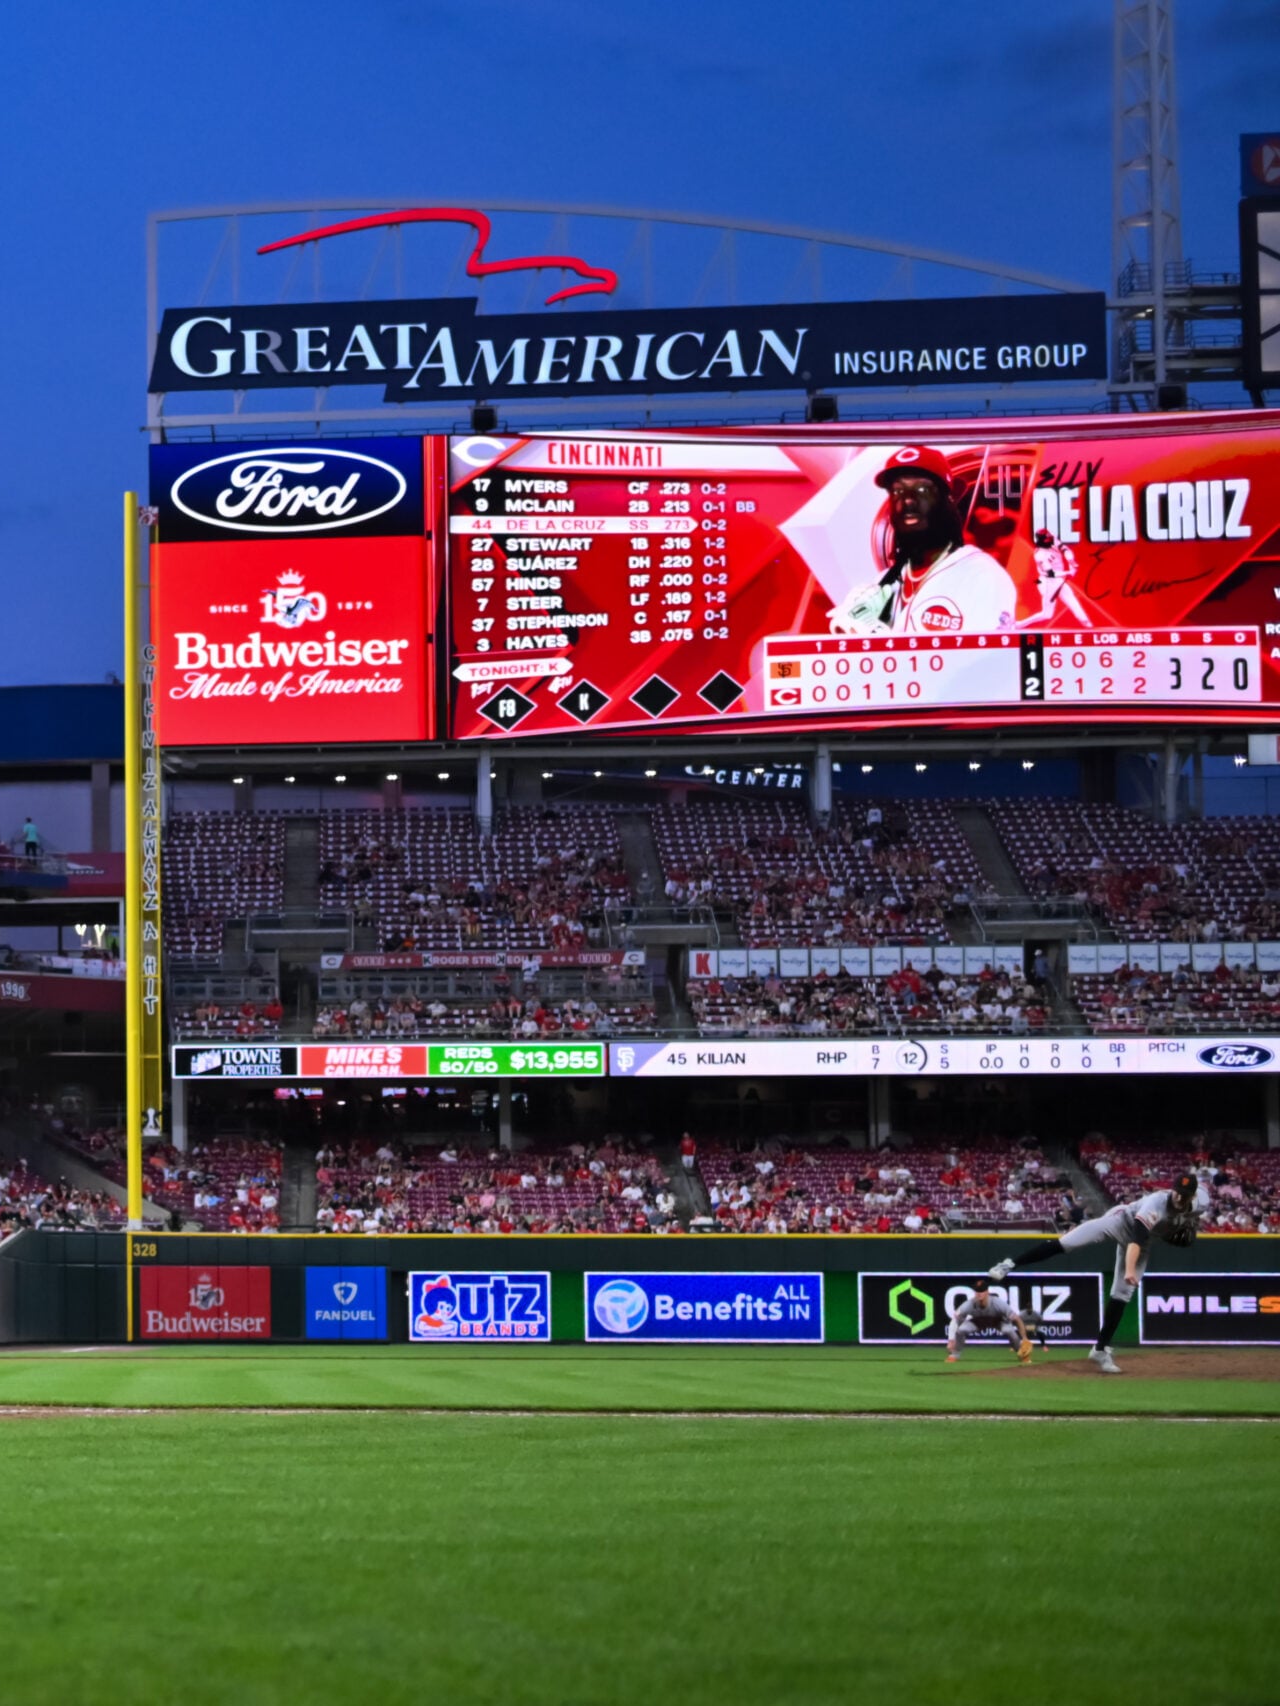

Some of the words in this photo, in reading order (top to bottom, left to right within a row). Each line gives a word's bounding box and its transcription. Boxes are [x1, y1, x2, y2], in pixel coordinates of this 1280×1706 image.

[170, 316, 429, 378] GREAT
[402, 327, 810, 391] AMERICAN
[833, 347, 988, 376] INSURANCE
[996, 342, 1088, 371] GROUP
[548, 443, 662, 467] CINCINNATI
[216, 460, 361, 518] Ford
[472, 479, 491, 493] 17
[505, 480, 568, 493] MYERS
[628, 482, 649, 494] CF
[659, 482, 691, 495] .273
[701, 483, 726, 495] 0-2
[476, 499, 488, 512] 9
[505, 500, 574, 512] MCLAIN
[628, 501, 650, 513] 2B
[660, 501, 691, 512] .213
[702, 501, 725, 513] 0-1
[736, 501, 756, 512] BB
[1032, 486, 1080, 543] DE
[1089, 485, 1138, 543] LA
[1144, 479, 1252, 541] CRUZ
[472, 519, 492, 530] 44
[506, 520, 529, 530] DE
[535, 520, 557, 530] LA
[562, 520, 606, 530] CRUZ
[629, 519, 649, 530] SS
[701, 519, 727, 530] 0-2
[471, 539, 493, 551] 27
[506, 538, 592, 551] STEWART
[631, 538, 648, 550] 1B
[660, 538, 691, 550] .316
[703, 537, 725, 549] 1-2
[471, 558, 494, 572] 28
[506, 555, 577, 570] SUÁREZ
[628, 556, 651, 568] DH
[659, 556, 692, 568] .220
[703, 555, 726, 567] 0-1
[472, 578, 494, 591] 57
[506, 577, 562, 590] HINDS
[629, 575, 650, 587] RF
[659, 574, 693, 586] .000
[702, 574, 728, 585] 0-2
[209, 604, 248, 613] SINCE
[337, 601, 373, 610] 1876
[477, 599, 489, 611] 7
[506, 597, 563, 610] STEER
[630, 593, 650, 606] LF
[661, 592, 692, 605] .189
[704, 591, 726, 603] 1-2
[472, 618, 495, 631] 37
[506, 614, 608, 630] STEPHENSON
[634, 612, 647, 625] C
[662, 611, 691, 623] .167
[704, 610, 727, 621] 0-1
[921, 611, 962, 629] REDS
[477, 638, 490, 652] 3
[506, 635, 569, 650] HAYES
[629, 630, 652, 643] 3B
[661, 629, 693, 642] .075
[703, 628, 728, 640] 0-2
[1093, 634, 1118, 644] LOB
[1126, 633, 1152, 643] ABS
[174, 631, 409, 669] Budweiser
[468, 664, 546, 677] TONIGHT:
[549, 662, 558, 672] K
[169, 671, 258, 700] Made
[260, 671, 293, 702] of
[285, 670, 403, 697] America
[498, 699, 516, 717] F8
[579, 693, 589, 711] K
[716, 770, 802, 788] CENTER
[0, 981, 25, 999] 1990
[444, 1048, 493, 1059] REDS
[986, 1044, 997, 1053] IP
[1109, 1043, 1126, 1053] BB
[1148, 1043, 1185, 1053] PITCH
[1211, 1046, 1258, 1066] Ford
[222, 1049, 281, 1064] TOWNE
[510, 1050, 598, 1072] $13,955
[667, 1053, 687, 1065] 45
[696, 1053, 746, 1065] KILIAN
[816, 1052, 848, 1064] RHP
[903, 1053, 918, 1064] 12
[980, 1057, 1004, 1069] 0.0
[222, 1065, 282, 1076] PROPERTIES
[324, 1065, 402, 1077] CARWASH
[439, 1061, 498, 1074] 50/50
[133, 1244, 157, 1257] 328
[774, 1284, 810, 1299] ALL
[654, 1292, 783, 1321] Benefits
[789, 1304, 810, 1319] IN
[146, 1310, 265, 1333] Budweiser
[315, 1311, 375, 1321] FANDUEL
[460, 1323, 538, 1336] BRANDS
